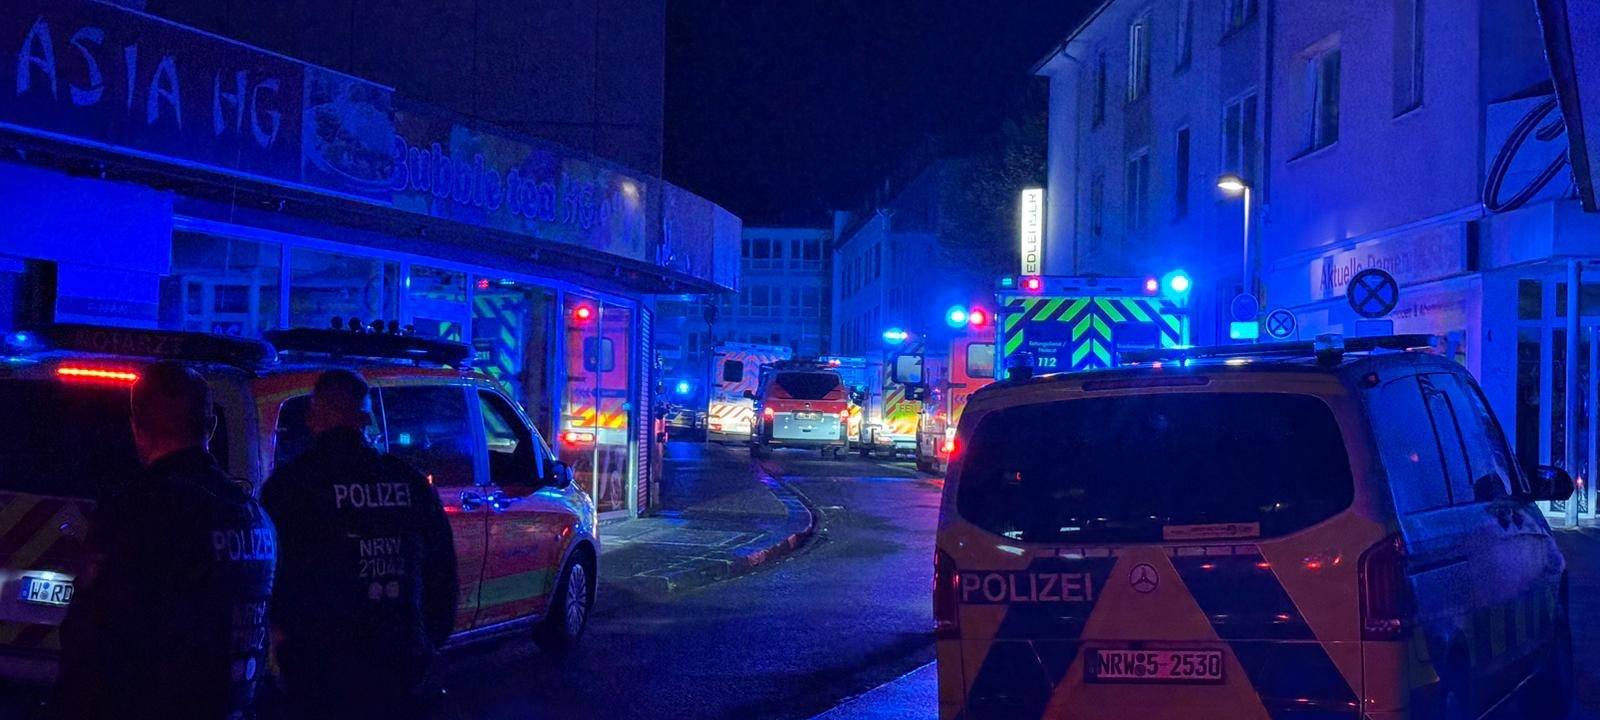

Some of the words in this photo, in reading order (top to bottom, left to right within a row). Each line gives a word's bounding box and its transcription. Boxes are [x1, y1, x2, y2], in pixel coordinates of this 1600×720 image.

[16, 15, 183, 132] ASIA
[213, 68, 281, 149] HG
[1037, 357, 1057, 367] 112
[333, 482, 412, 509] POLIZEI
[358, 536, 401, 557] NRW
[961, 572, 1093, 602] POLIZEI
